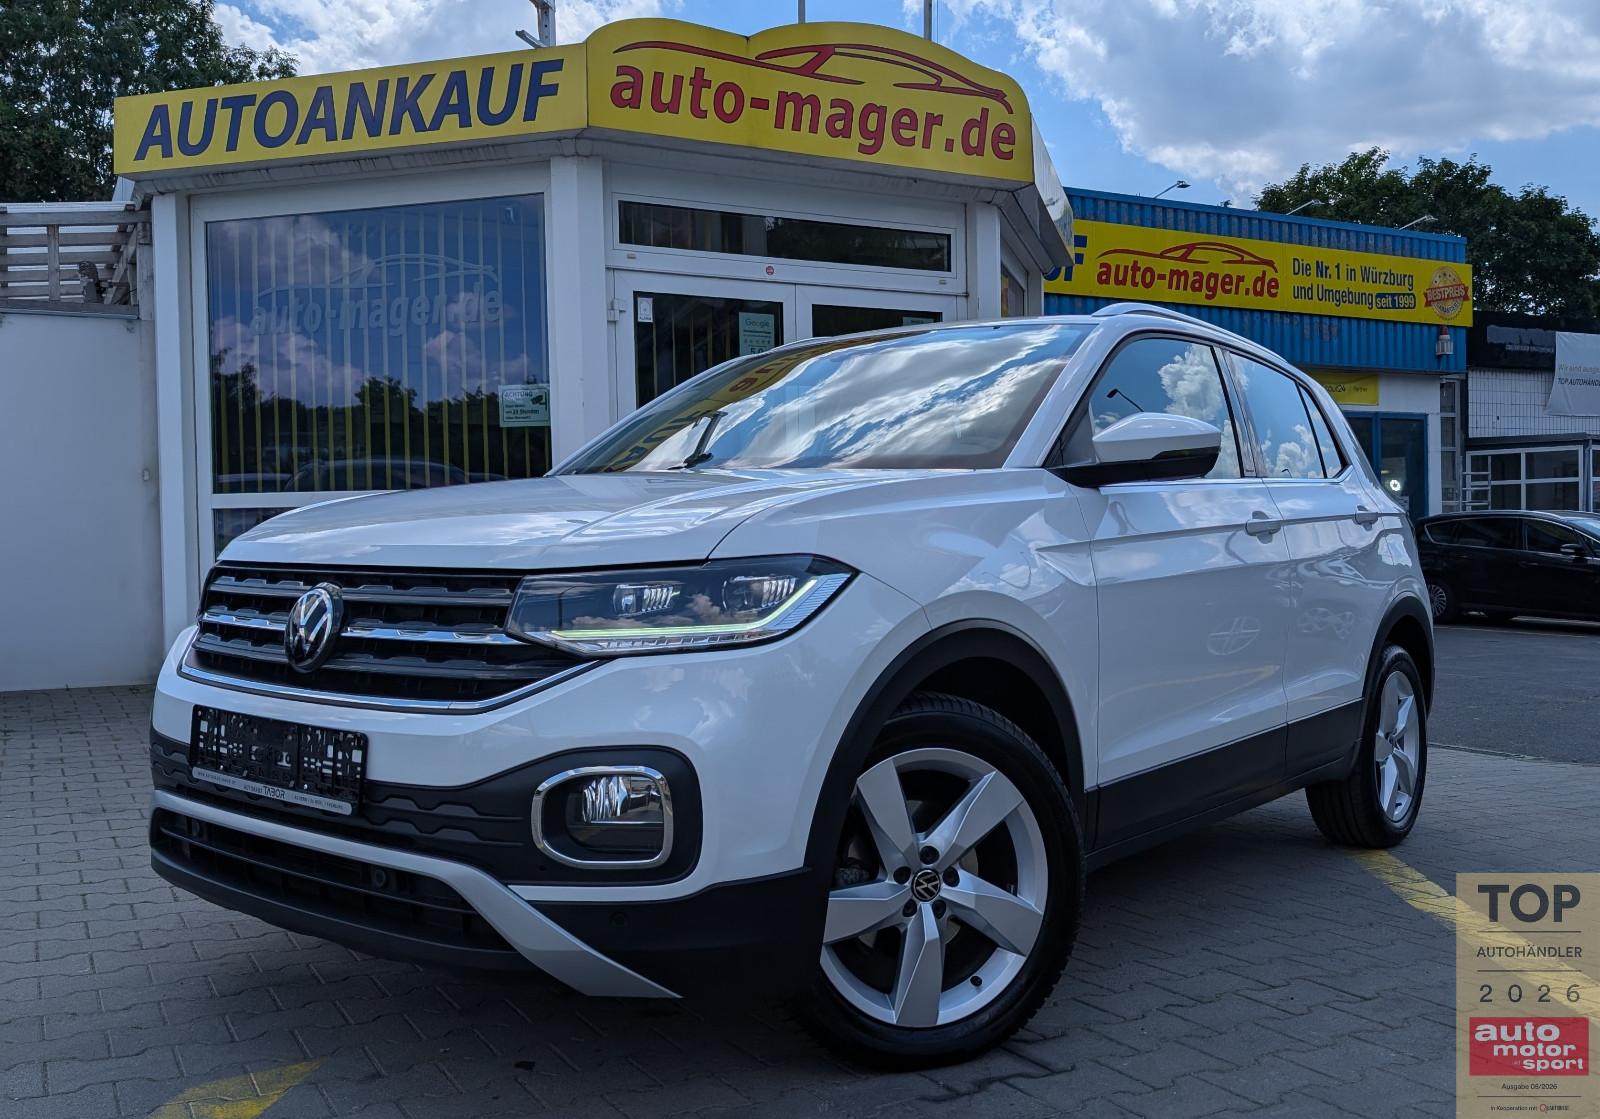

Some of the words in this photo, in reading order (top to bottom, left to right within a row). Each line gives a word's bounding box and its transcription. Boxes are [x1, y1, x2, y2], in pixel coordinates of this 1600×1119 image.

[134, 59, 564, 161] AUTOANKAUF
[610, 65, 1016, 161] auto-mager.de
[1097, 259, 1280, 300] auto-mager.de
[1292, 257, 1312, 278] Die
[1315, 261, 1332, 280] Nr.
[1334, 264, 1341, 281] 1
[1346, 264, 1357, 282] in
[1360, 265, 1414, 291] Würzburg
[1428, 285, 1465, 301] BESTPREIS
[249, 281, 502, 337] auto-mager.de
[1292, 283, 1314, 301] und
[1316, 284, 1374, 310] Umgebung
[1376, 294, 1393, 309] seit
[1393, 294, 1414, 309] 1999
